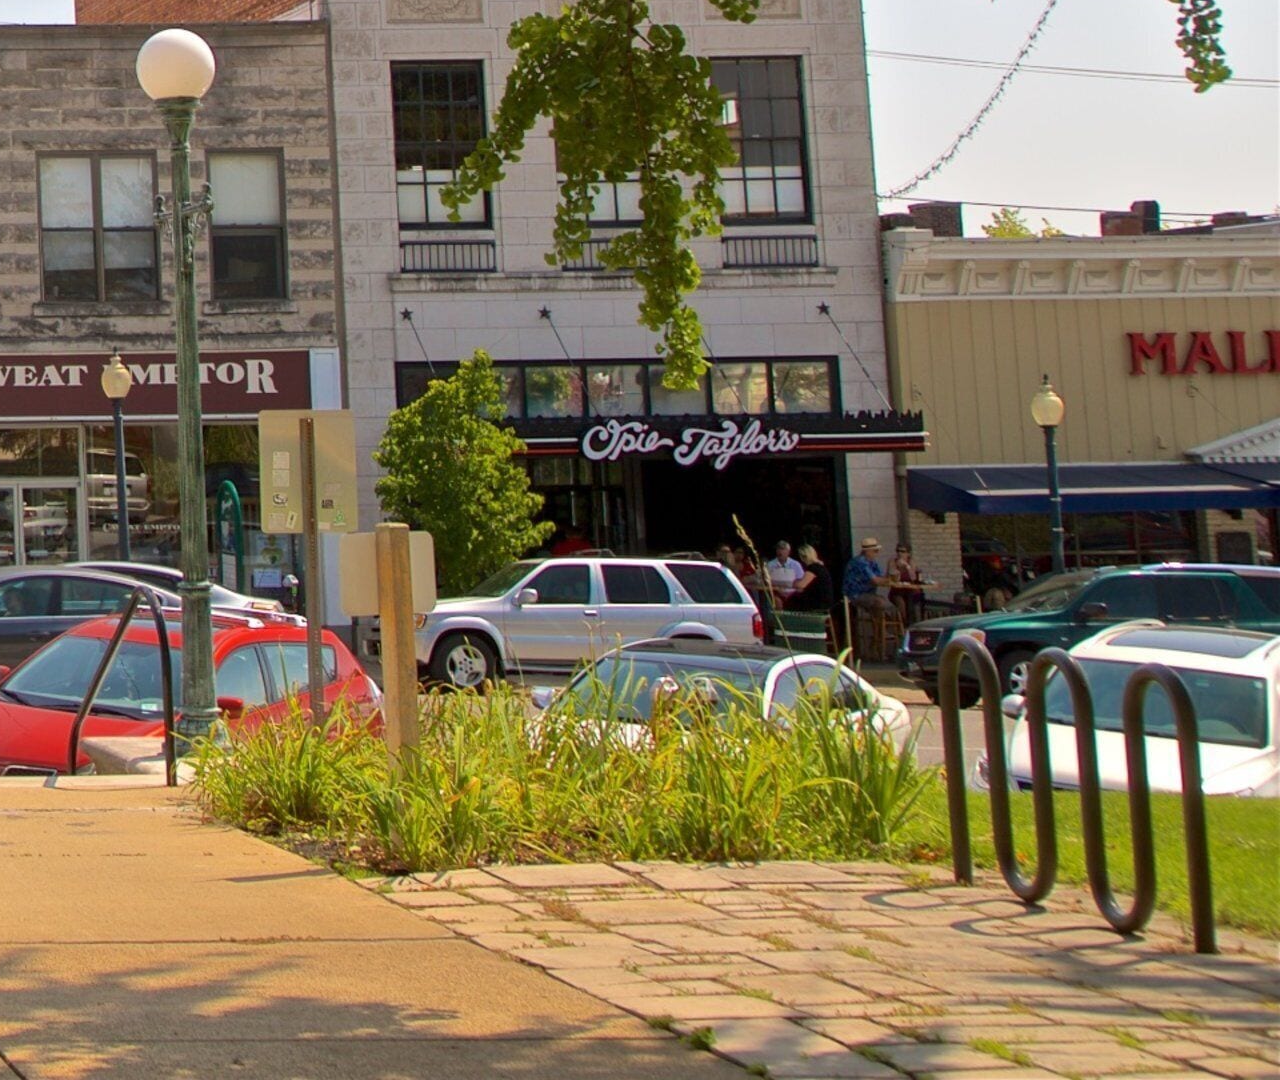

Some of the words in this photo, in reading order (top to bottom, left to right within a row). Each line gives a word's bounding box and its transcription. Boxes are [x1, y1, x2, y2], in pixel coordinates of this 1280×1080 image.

[101, 359, 278, 395] MPTOR
[582, 419, 674, 461] Opie
[673, 419, 800, 471] Taylor's
